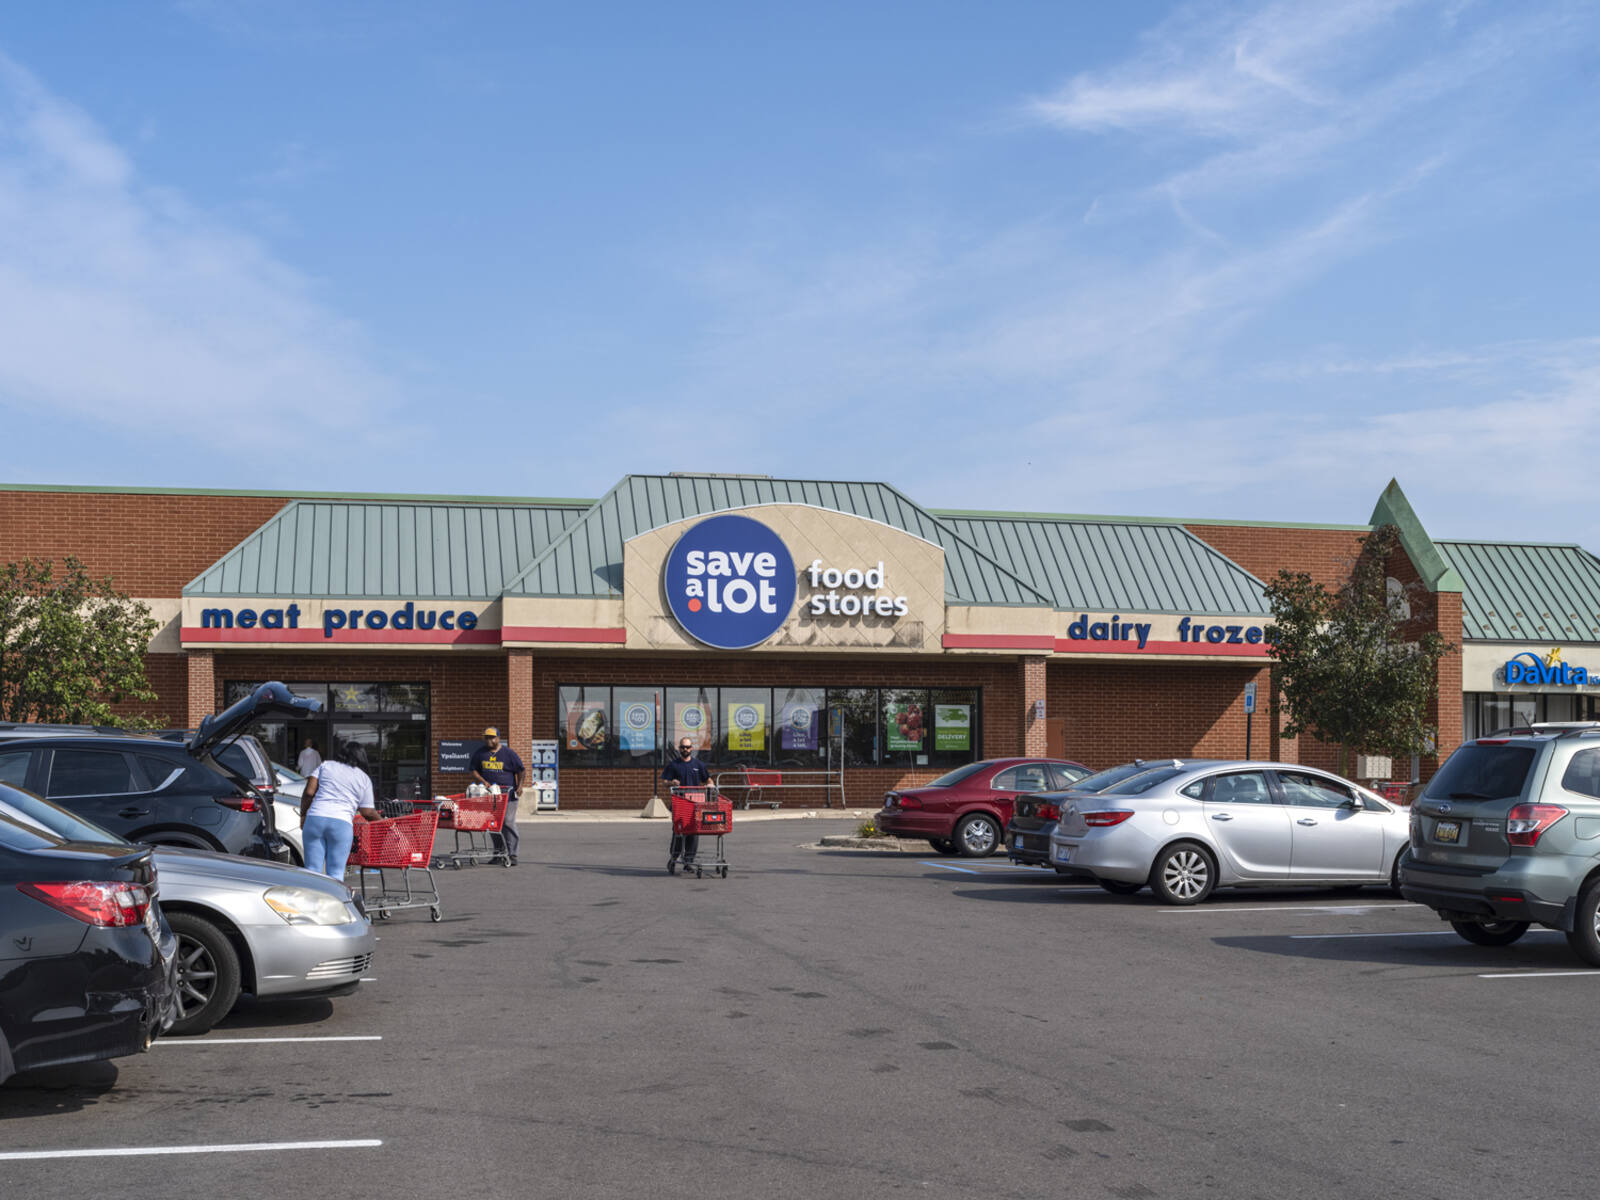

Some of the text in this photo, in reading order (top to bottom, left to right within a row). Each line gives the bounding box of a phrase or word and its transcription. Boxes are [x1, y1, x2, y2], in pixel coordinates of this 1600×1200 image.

[686, 550, 776, 577] save
[808, 559, 885, 590] food
[685, 578, 777, 614] a lot
[810, 590, 909, 616] stores
[201, 602, 478, 638] meat produce
[1068, 614, 1152, 649] dairy
[1505, 652, 1588, 685] DaVita
[441, 752, 470, 760] Ypsilanti
